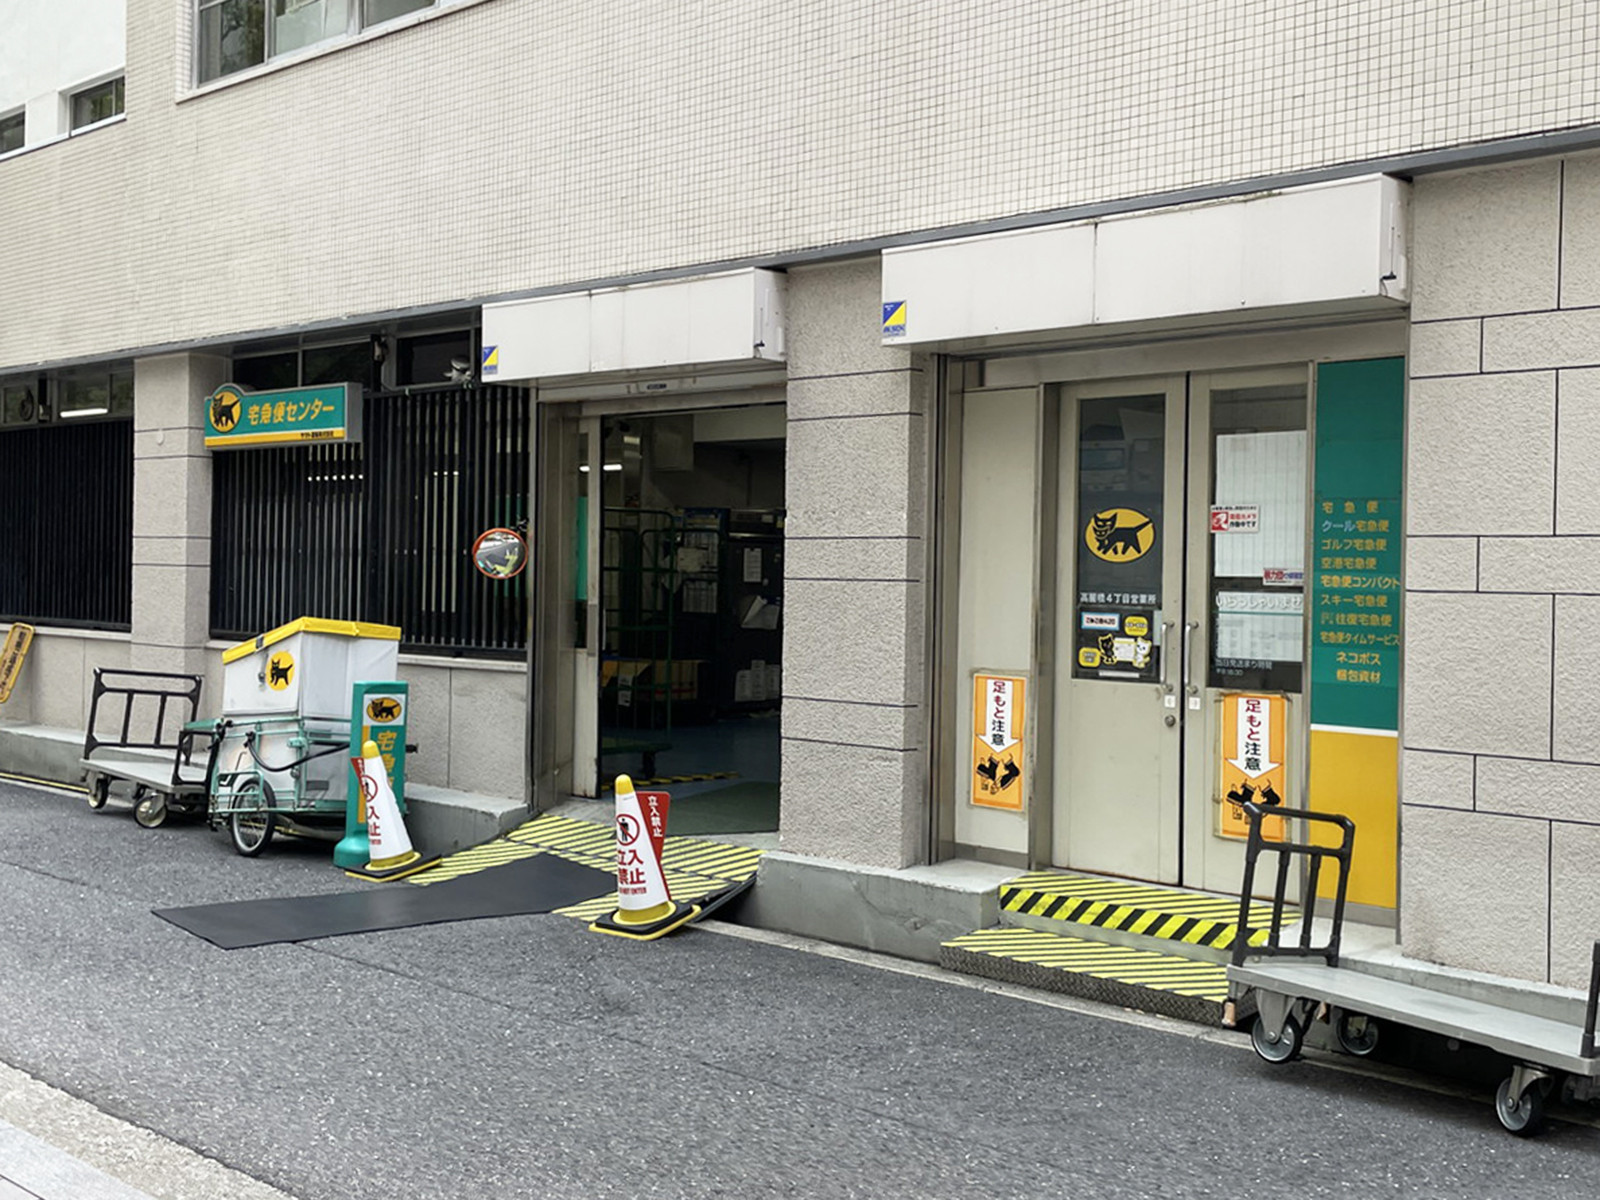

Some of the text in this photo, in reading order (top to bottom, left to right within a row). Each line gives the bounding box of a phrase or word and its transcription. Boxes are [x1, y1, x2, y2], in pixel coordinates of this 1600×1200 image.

[248, 398, 334, 425] 宅急便センター
[1322, 520, 1389, 533] クール宅急便
[1322, 539, 1387, 551] ゴルフ宅急便
[1321, 575, 1400, 590] 宅急便コンパクト
[1321, 594, 1388, 608] スキー宅急便
[1320, 631, 1400, 646] 宅急便タイムサービス
[1336, 651, 1381, 666] ネコポス
[991, 680, 1006, 746] 足もと注意
[1244, 699, 1262, 771] 足もと注意
[376, 731, 397, 788] 宅急
